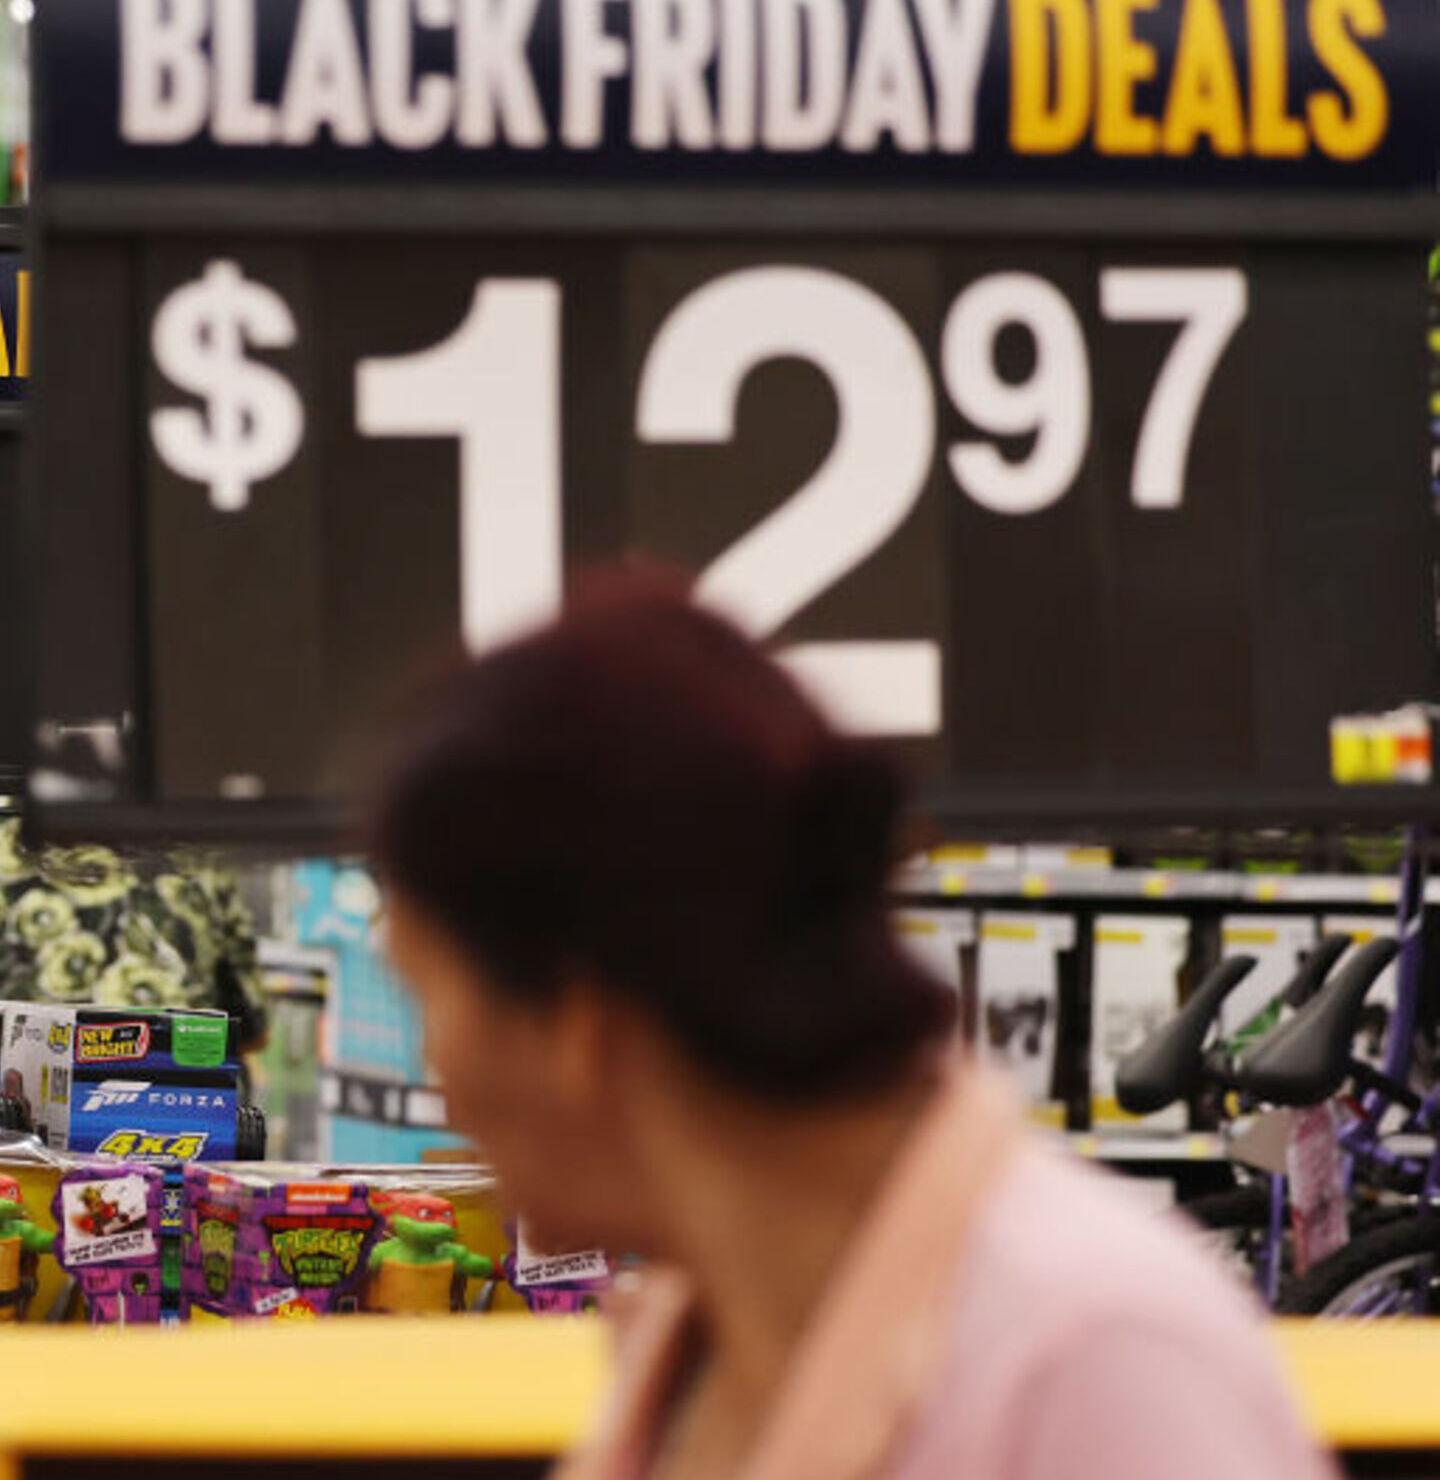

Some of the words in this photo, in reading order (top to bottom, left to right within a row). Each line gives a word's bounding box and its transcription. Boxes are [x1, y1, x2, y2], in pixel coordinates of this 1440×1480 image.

[119, 0, 548, 148] BLACK
[560, 0, 996, 152] FRIDAY
[1007, 0, 1390, 160] DEALS
[148, 1092, 225, 1108] FORZA
